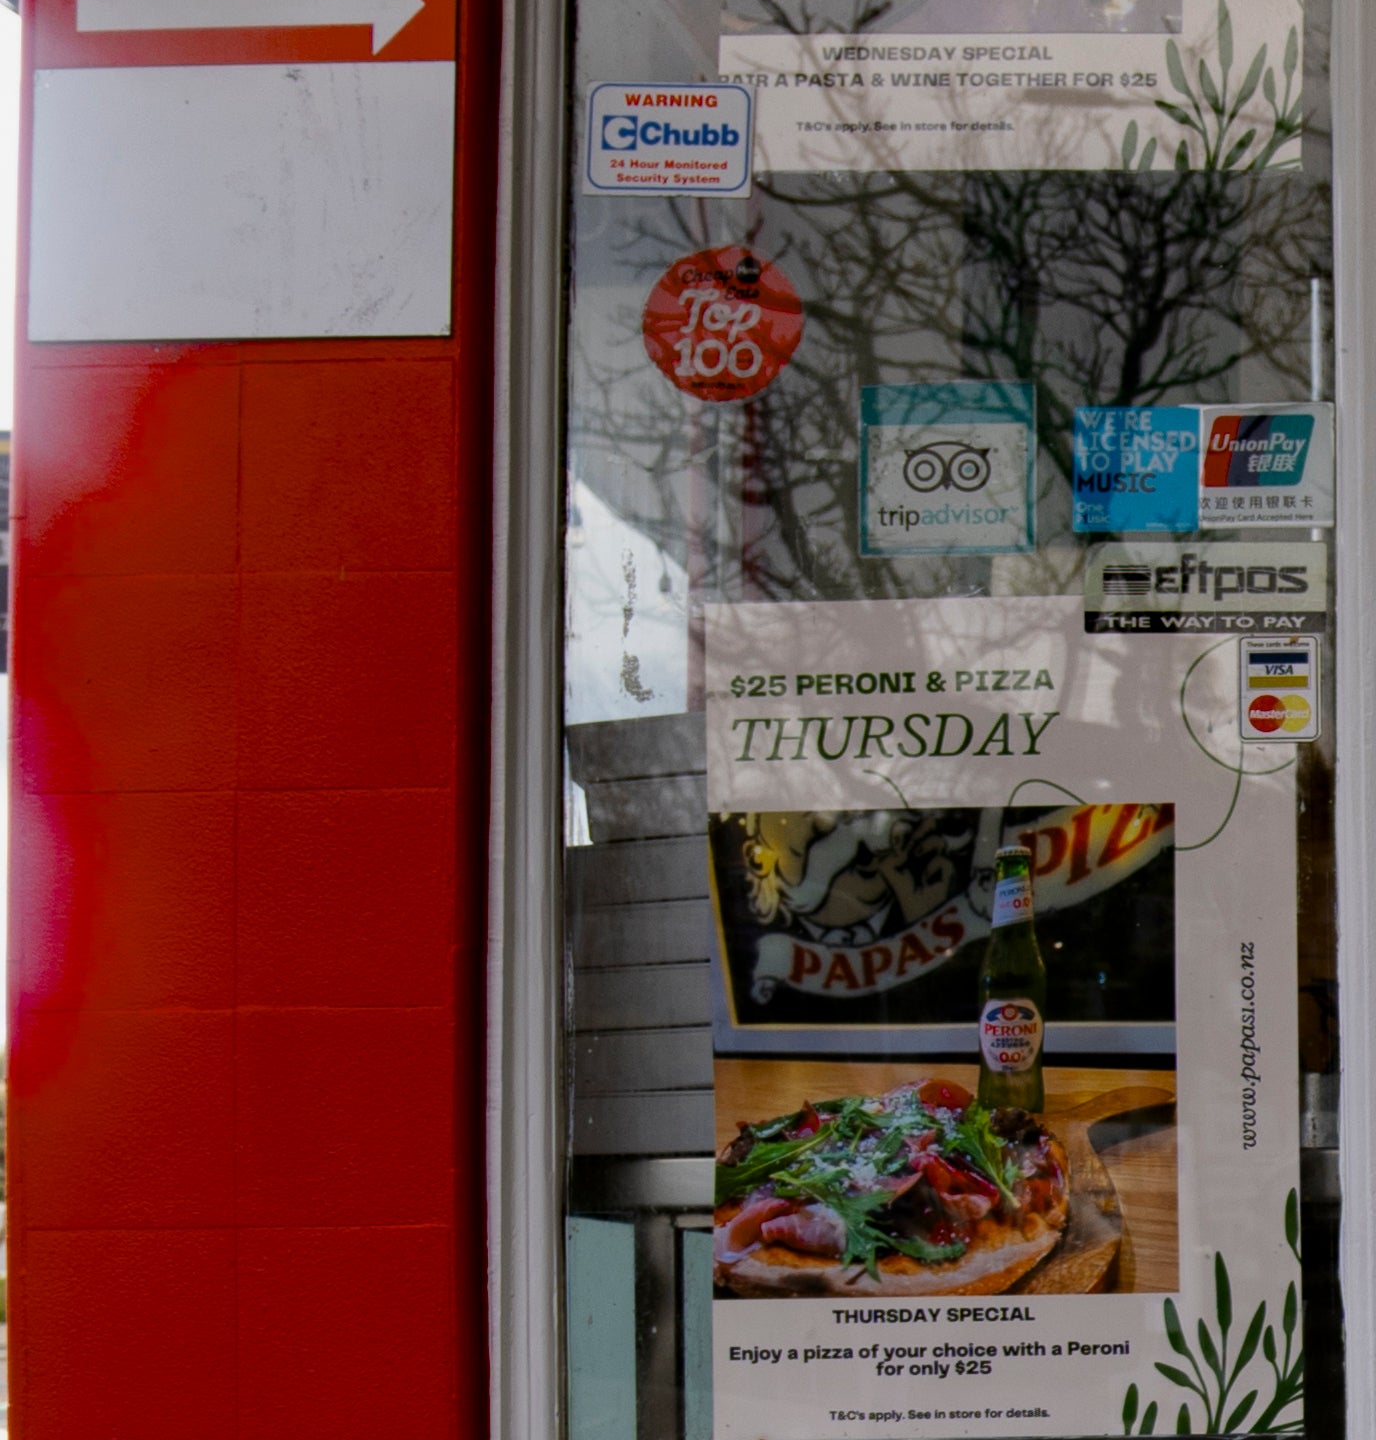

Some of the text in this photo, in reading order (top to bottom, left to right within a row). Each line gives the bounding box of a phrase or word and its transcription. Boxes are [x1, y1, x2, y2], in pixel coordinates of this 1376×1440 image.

[821, 46, 1053, 61] WEDNESDAY SPECIAL
[774, 73, 789, 87] A
[795, 73, 865, 87] PASTA
[871, 73, 885, 87] &
[891, 73, 951, 87] WINE
[956, 73, 1067, 88] TOGETHER
[1072, 73, 1114, 88] FOR
[1119, 72, 1158, 88] $25
[624, 93, 719, 108] WARNING
[639, 121, 740, 147] Chubb
[874, 121, 897, 132] See
[901, 121, 912, 132] in
[915, 122, 947, 132] store
[950, 121, 969, 131] for
[610, 159, 728, 170] 24 Hour Monitored
[616, 173, 721, 185] Security System
[678, 288, 762, 343] Top
[673, 338, 763, 378] 100
[1079, 410, 1153, 432] WE'RE
[1076, 431, 1197, 453] LICENSED
[1211, 432, 1306, 456] UnionPay
[1080, 451, 1179, 473] TO PLAY
[1247, 454, 1298, 473] 银联
[1077, 472, 1157, 493] MUSIC
[1154, 553, 1309, 602] eftpos
[1105, 616, 1307, 628] THE WAY TO PAY
[1265, 665, 1294, 675] VISA
[730, 668, 1055, 698] $25 PERONI & PIZZA
[731, 711, 1061, 762] THURSDAY
[788, 905, 967, 992] PAPA'S
[984, 1022, 1038, 1037] PERONI
[1240, 941, 1262, 1151] www.papasi.co.nz
[832, 1307, 1036, 1324] THURSDAY SPECIAL
[729, 1340, 1131, 1364] Enjoy a pizza of your choice with a Peroni
[876, 1359, 993, 1379] for only $25
[829, 1407, 1051, 1423] T&C's apply. See in store for details.
